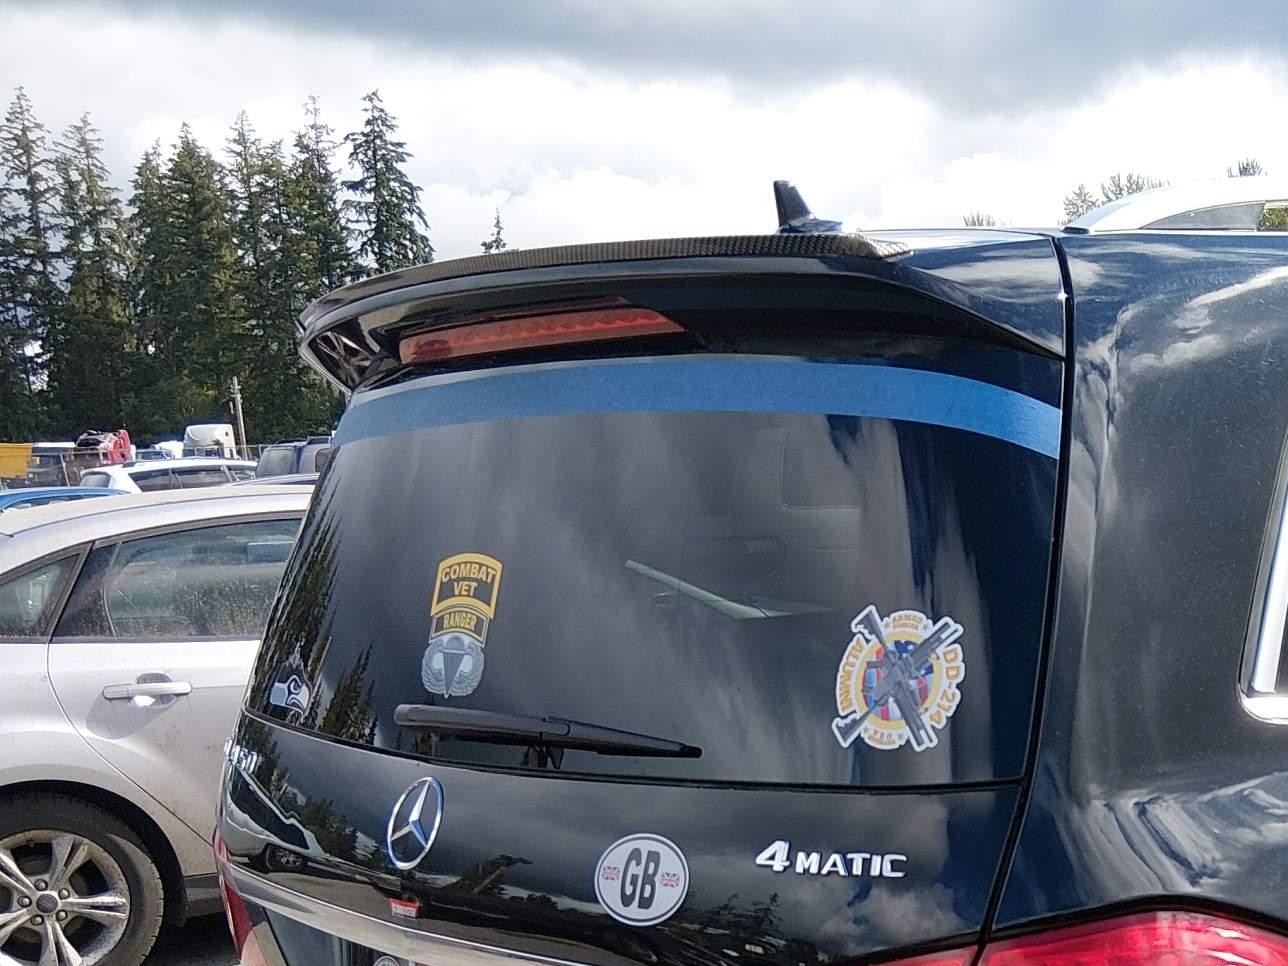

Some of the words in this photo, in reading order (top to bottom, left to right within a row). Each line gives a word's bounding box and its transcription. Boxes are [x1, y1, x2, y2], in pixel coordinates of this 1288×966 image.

[441, 563, 497, 584] COMBAT
[453, 581, 478, 596] VET
[443, 612, 477, 632] RANGER
[930, 648, 961, 724] DD-214
[620, 847, 661, 910] GB
